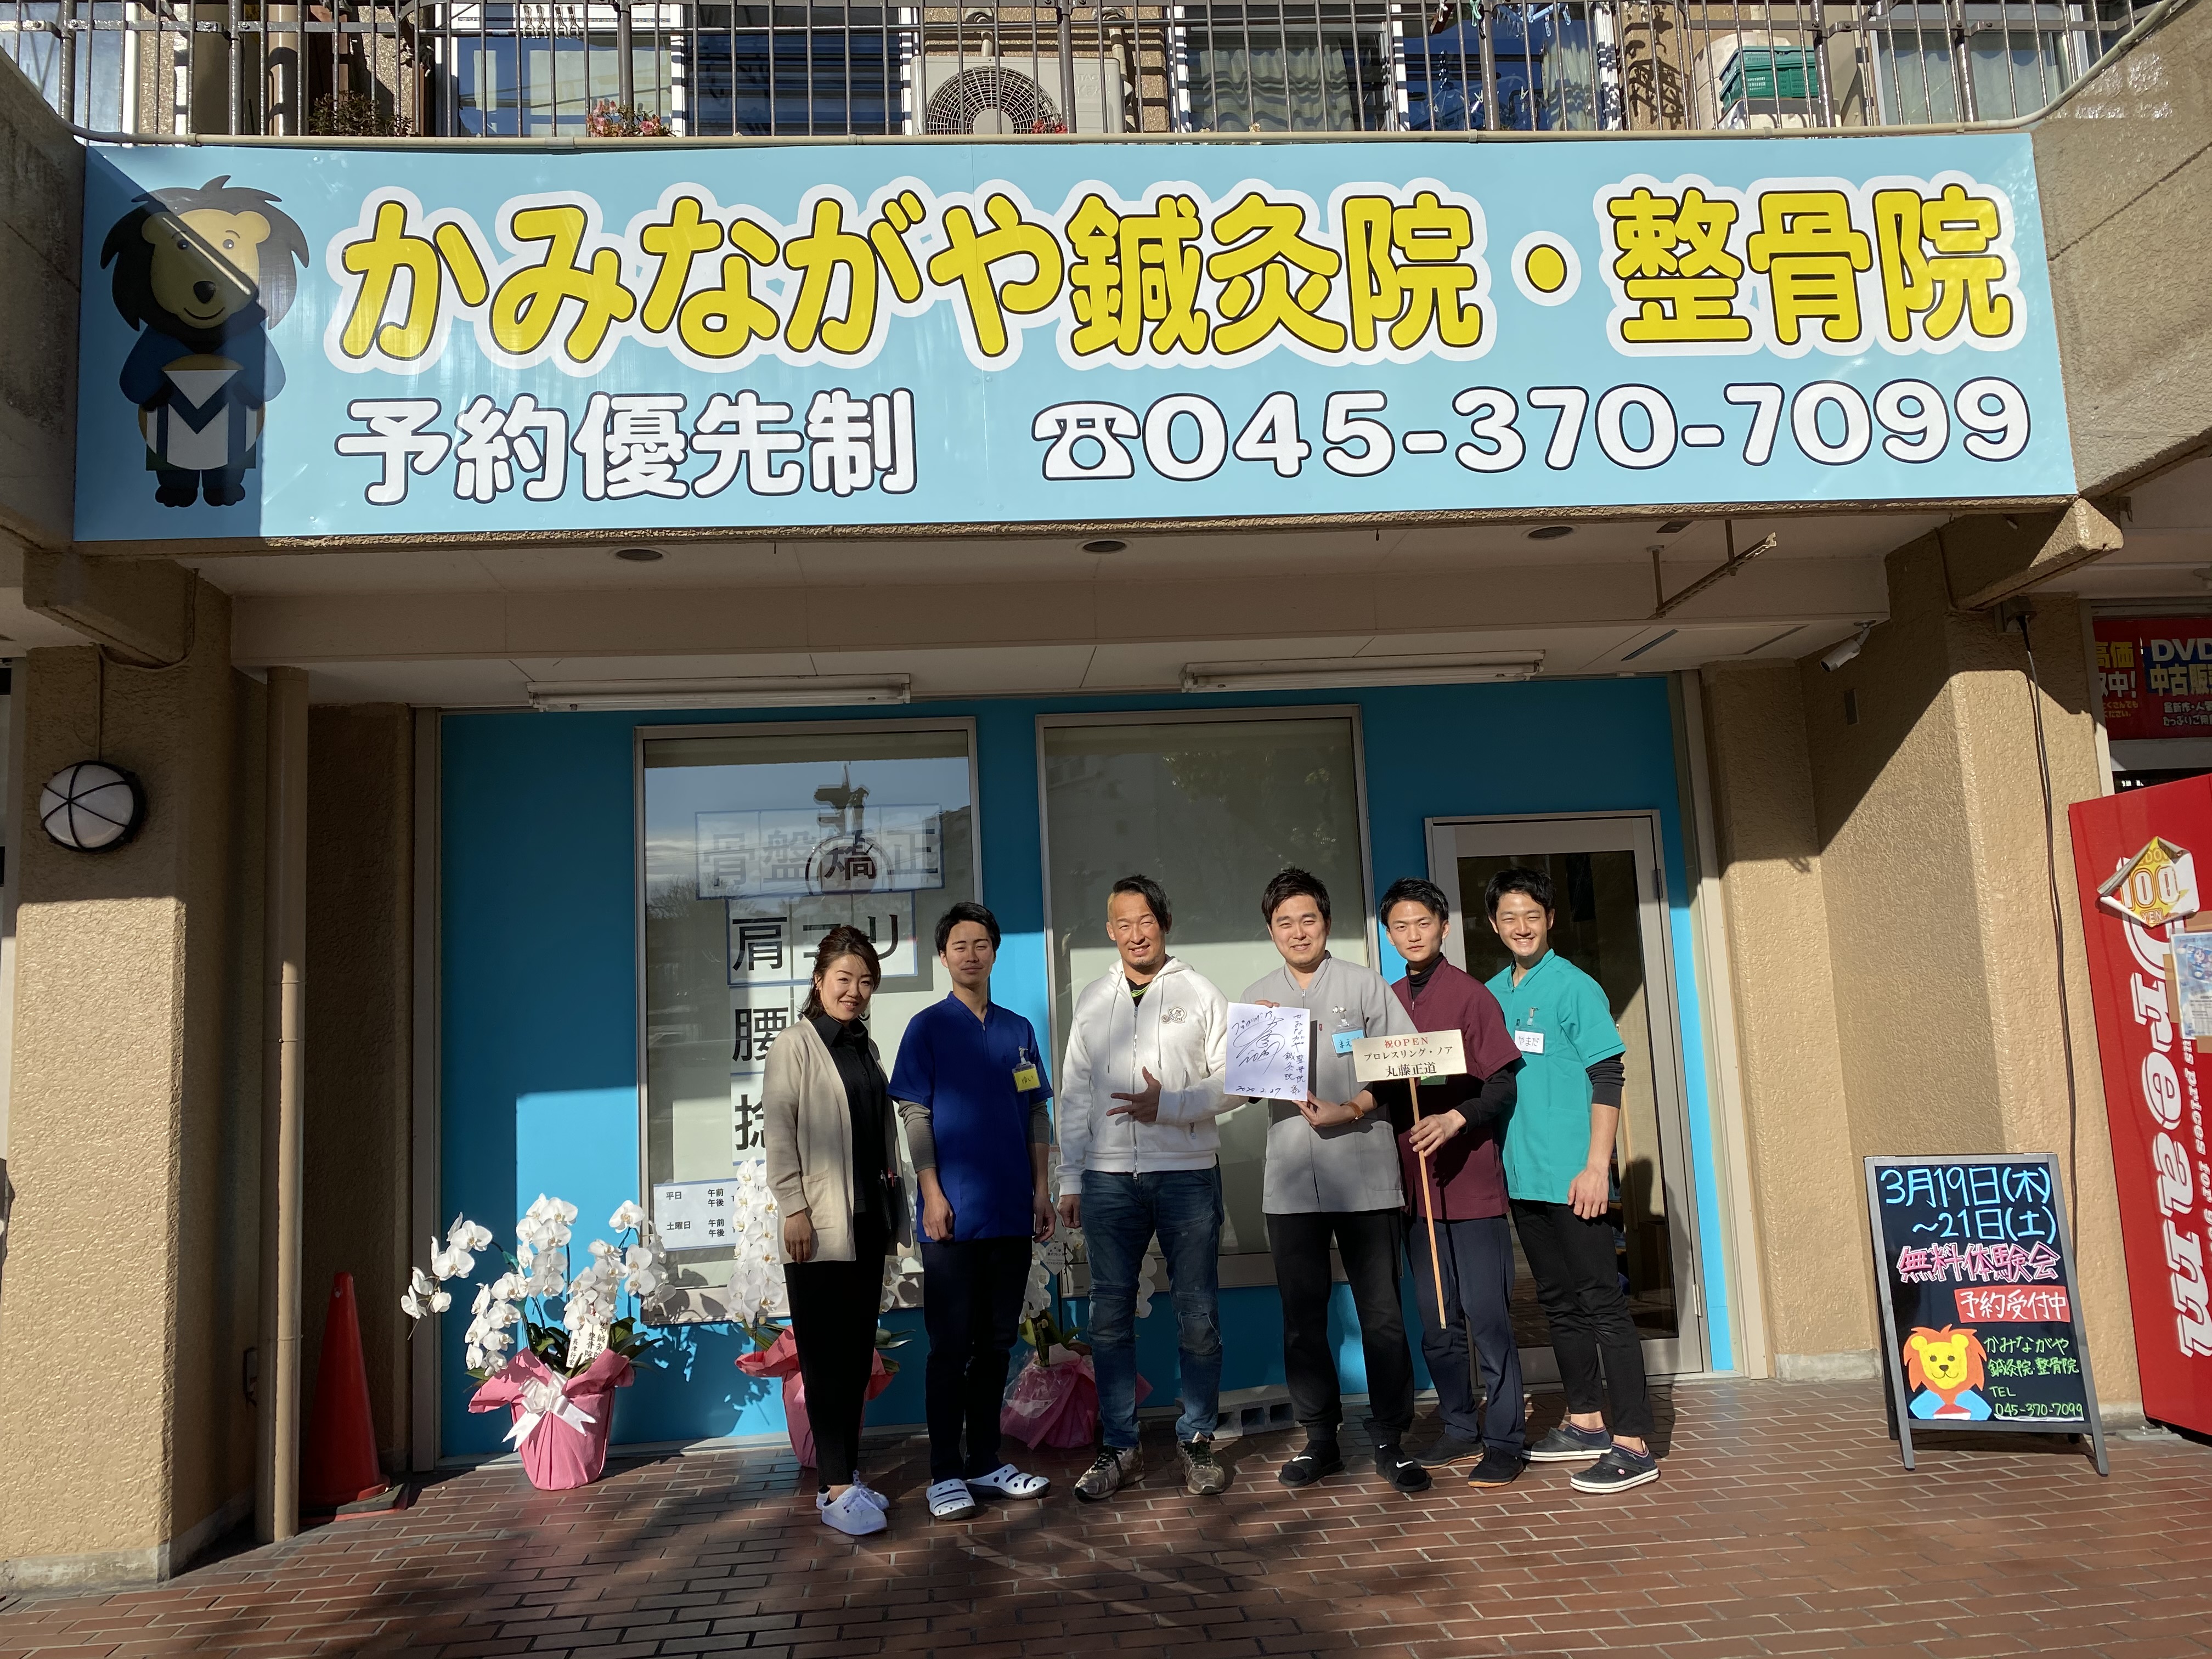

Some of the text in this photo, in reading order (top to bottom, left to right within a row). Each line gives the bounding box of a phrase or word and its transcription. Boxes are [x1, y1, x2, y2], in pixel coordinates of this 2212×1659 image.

[338, 183, 2012, 363] かみながや鍼灸院・整骨院
[1141, 376, 2030, 481] 045-370-7099
[335, 388, 916, 506] 予約優先制
[2151, 637, 2212, 662] DVD
[2149, 663, 2212, 696] 中古販
[703, 828, 938, 886] 骨盤矯正
[2140, 908, 2164, 924] YEN
[1519, 1036, 1539, 1047] やまだ
[1364, 1046, 1453, 1062] プロレスリング・ノア
[1386, 1062, 1437, 1078] 丸藤正道
[707, 1188, 724, 1198] 午前
[1880, 1166, 2051, 1207] 3月19日(木)
[665, 1191, 682, 1200] 平日
[707, 1198, 725, 1207] 午後
[666, 1221, 691, 1231] 土曜日
[708, 1218, 725, 1228] 午前
[708, 1228, 725, 1238] 午後
[1897, 1242, 2061, 1283] 無料体験会
[1960, 1289, 2067, 1320] 予約受付中
[1983, 1335, 2069, 1356] かみながや
[1989, 1386, 2017, 1398] TEL
[1994, 1402, 2084, 1417] 045-370-7099
